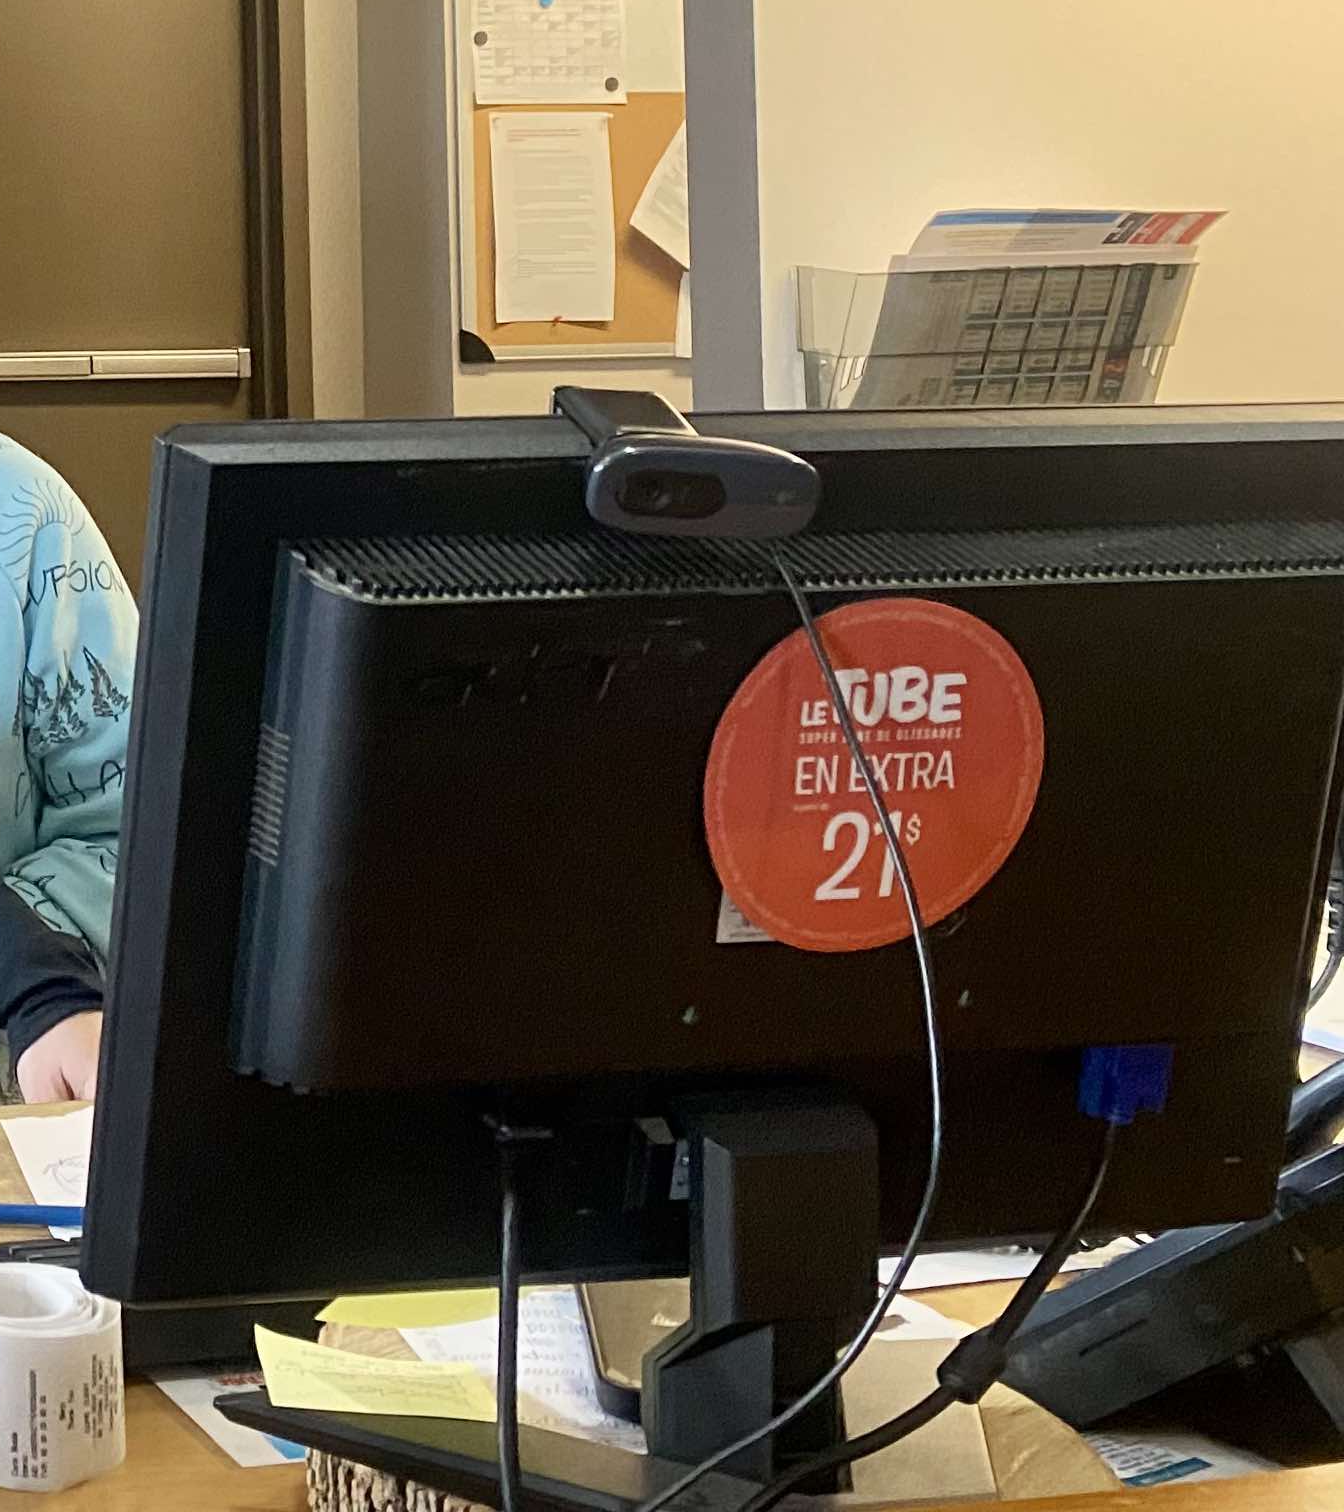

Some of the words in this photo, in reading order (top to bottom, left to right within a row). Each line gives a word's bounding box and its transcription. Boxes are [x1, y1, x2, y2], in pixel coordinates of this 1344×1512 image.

[800, 700, 828, 728] LE
[821, 665, 968, 728] TUBE
[794, 754, 840, 795] EN
[847, 749, 956, 793] EXTRA
